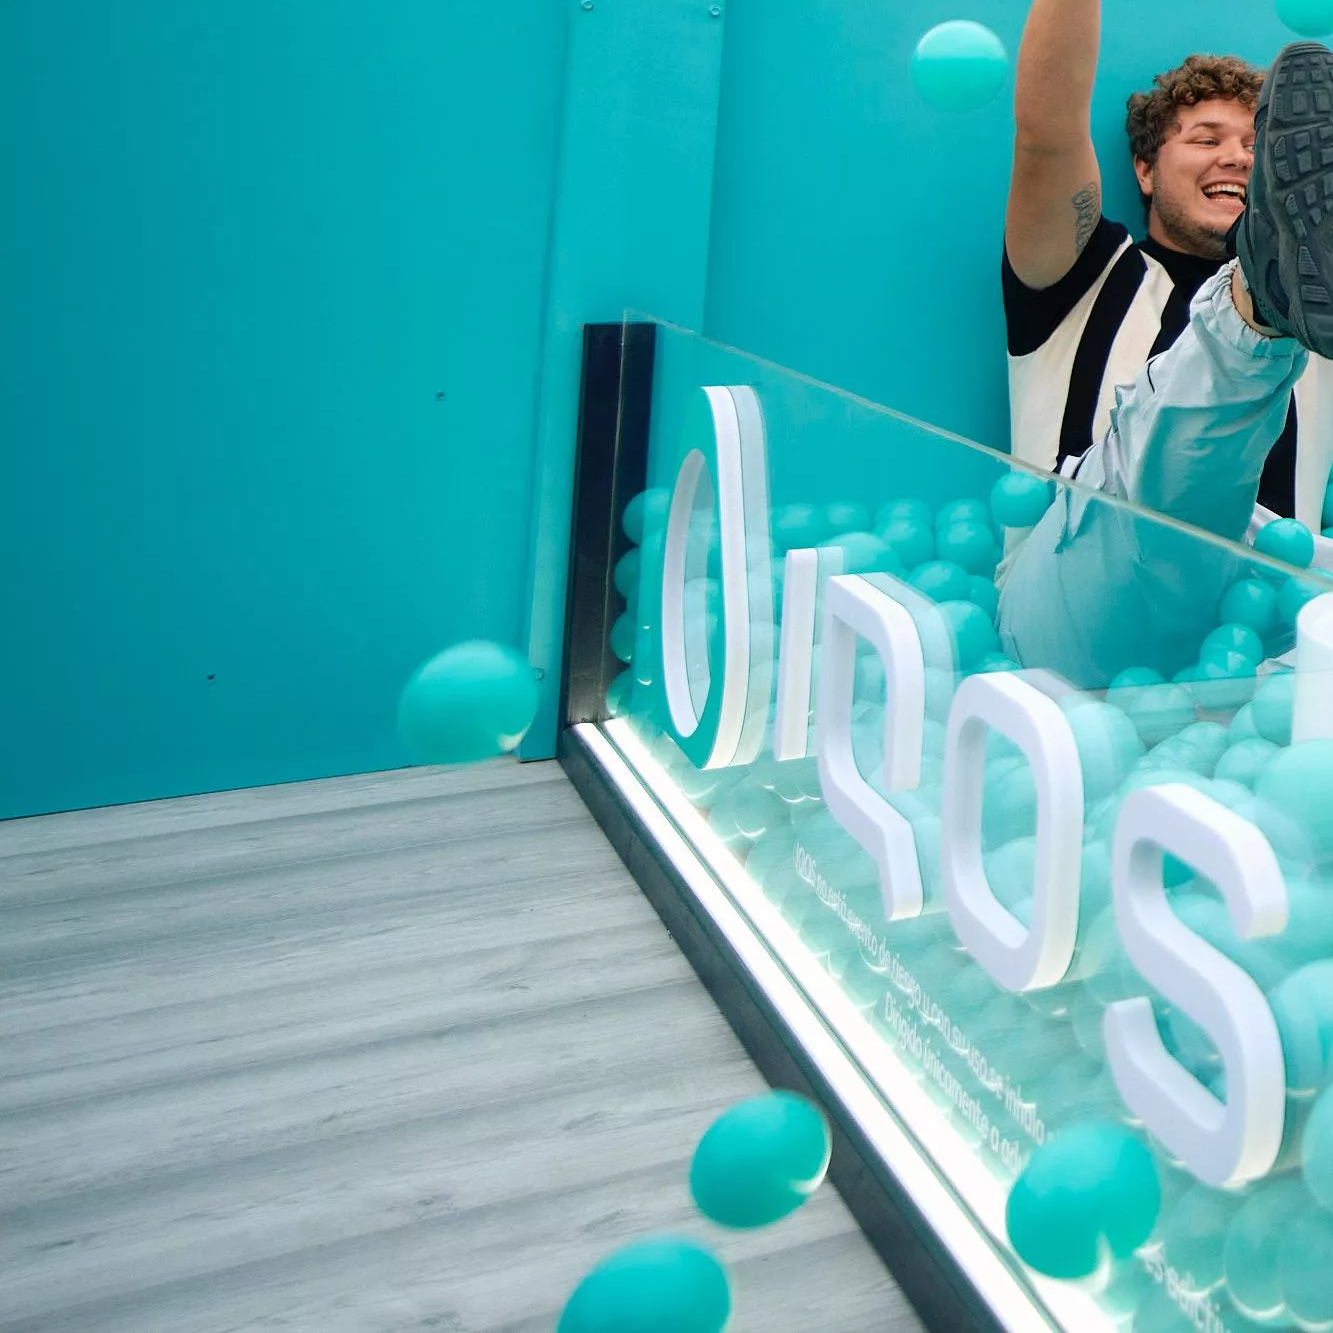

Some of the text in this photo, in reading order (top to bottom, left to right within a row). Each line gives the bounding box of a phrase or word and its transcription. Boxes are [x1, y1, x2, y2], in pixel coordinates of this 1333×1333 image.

[775, 548, 1287, 1186] IQOS
[878, 937, 891, 969] de
[892, 953, 922, 1006] riesgo
[1003, 1075, 1045, 1146] inhala
[885, 991, 922, 1059] Dirigido
[925, 1038, 990, 1140] únicamente
[990, 1126, 1001, 1155] a
